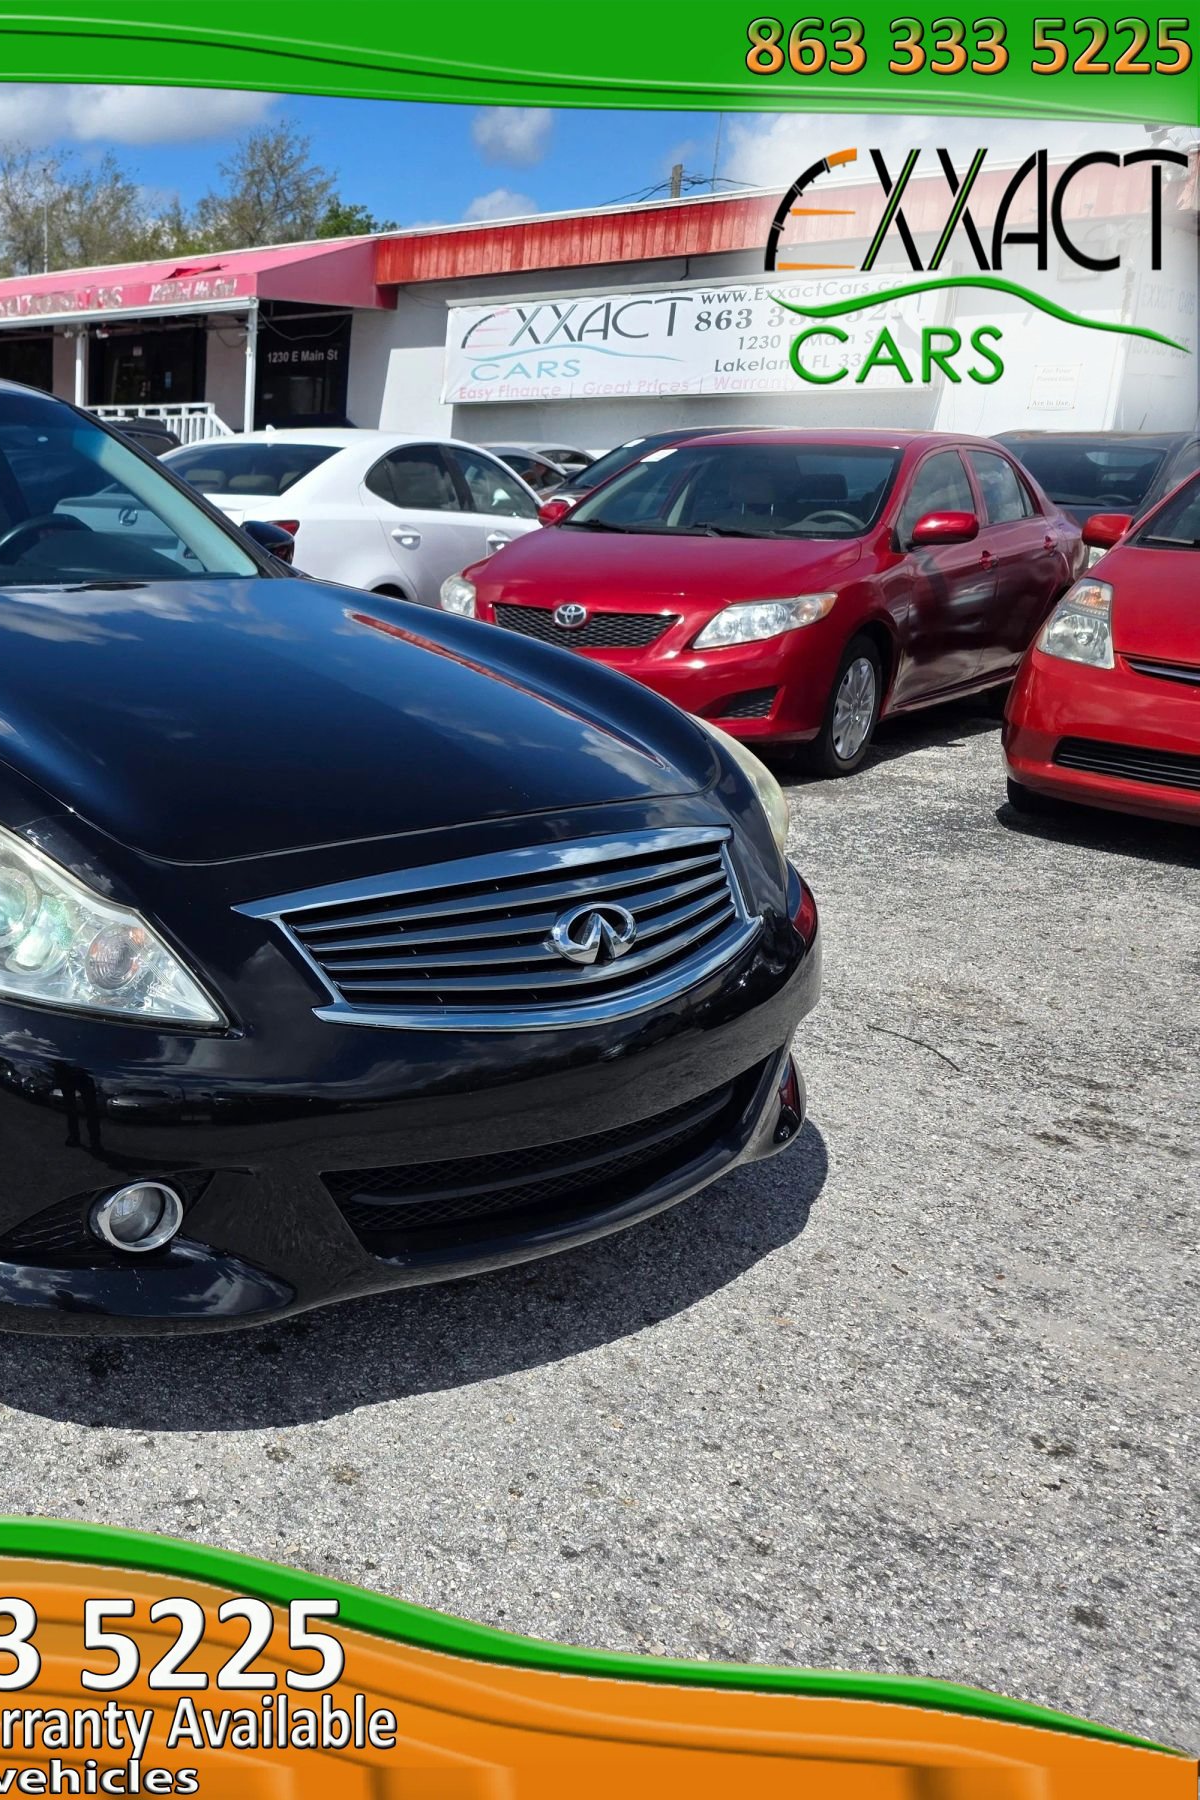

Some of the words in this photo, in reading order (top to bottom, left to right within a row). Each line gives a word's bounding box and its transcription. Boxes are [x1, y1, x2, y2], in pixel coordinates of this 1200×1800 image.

[461, 296, 693, 350] EXXACT
[694, 307, 753, 332] 863
[738, 334, 781, 351] 1230
[267, 351, 289, 363] 1230
[292, 350, 299, 362] E
[301, 350, 324, 362] Main
[327, 348, 338, 361] St
[813, 354, 830, 369] FL
[470, 360, 581, 382] CARS
[459, 386, 492, 400] Easy
[499, 383, 562, 398] Finance
[583, 380, 632, 395] Great
[638, 378, 689, 393] Prices
